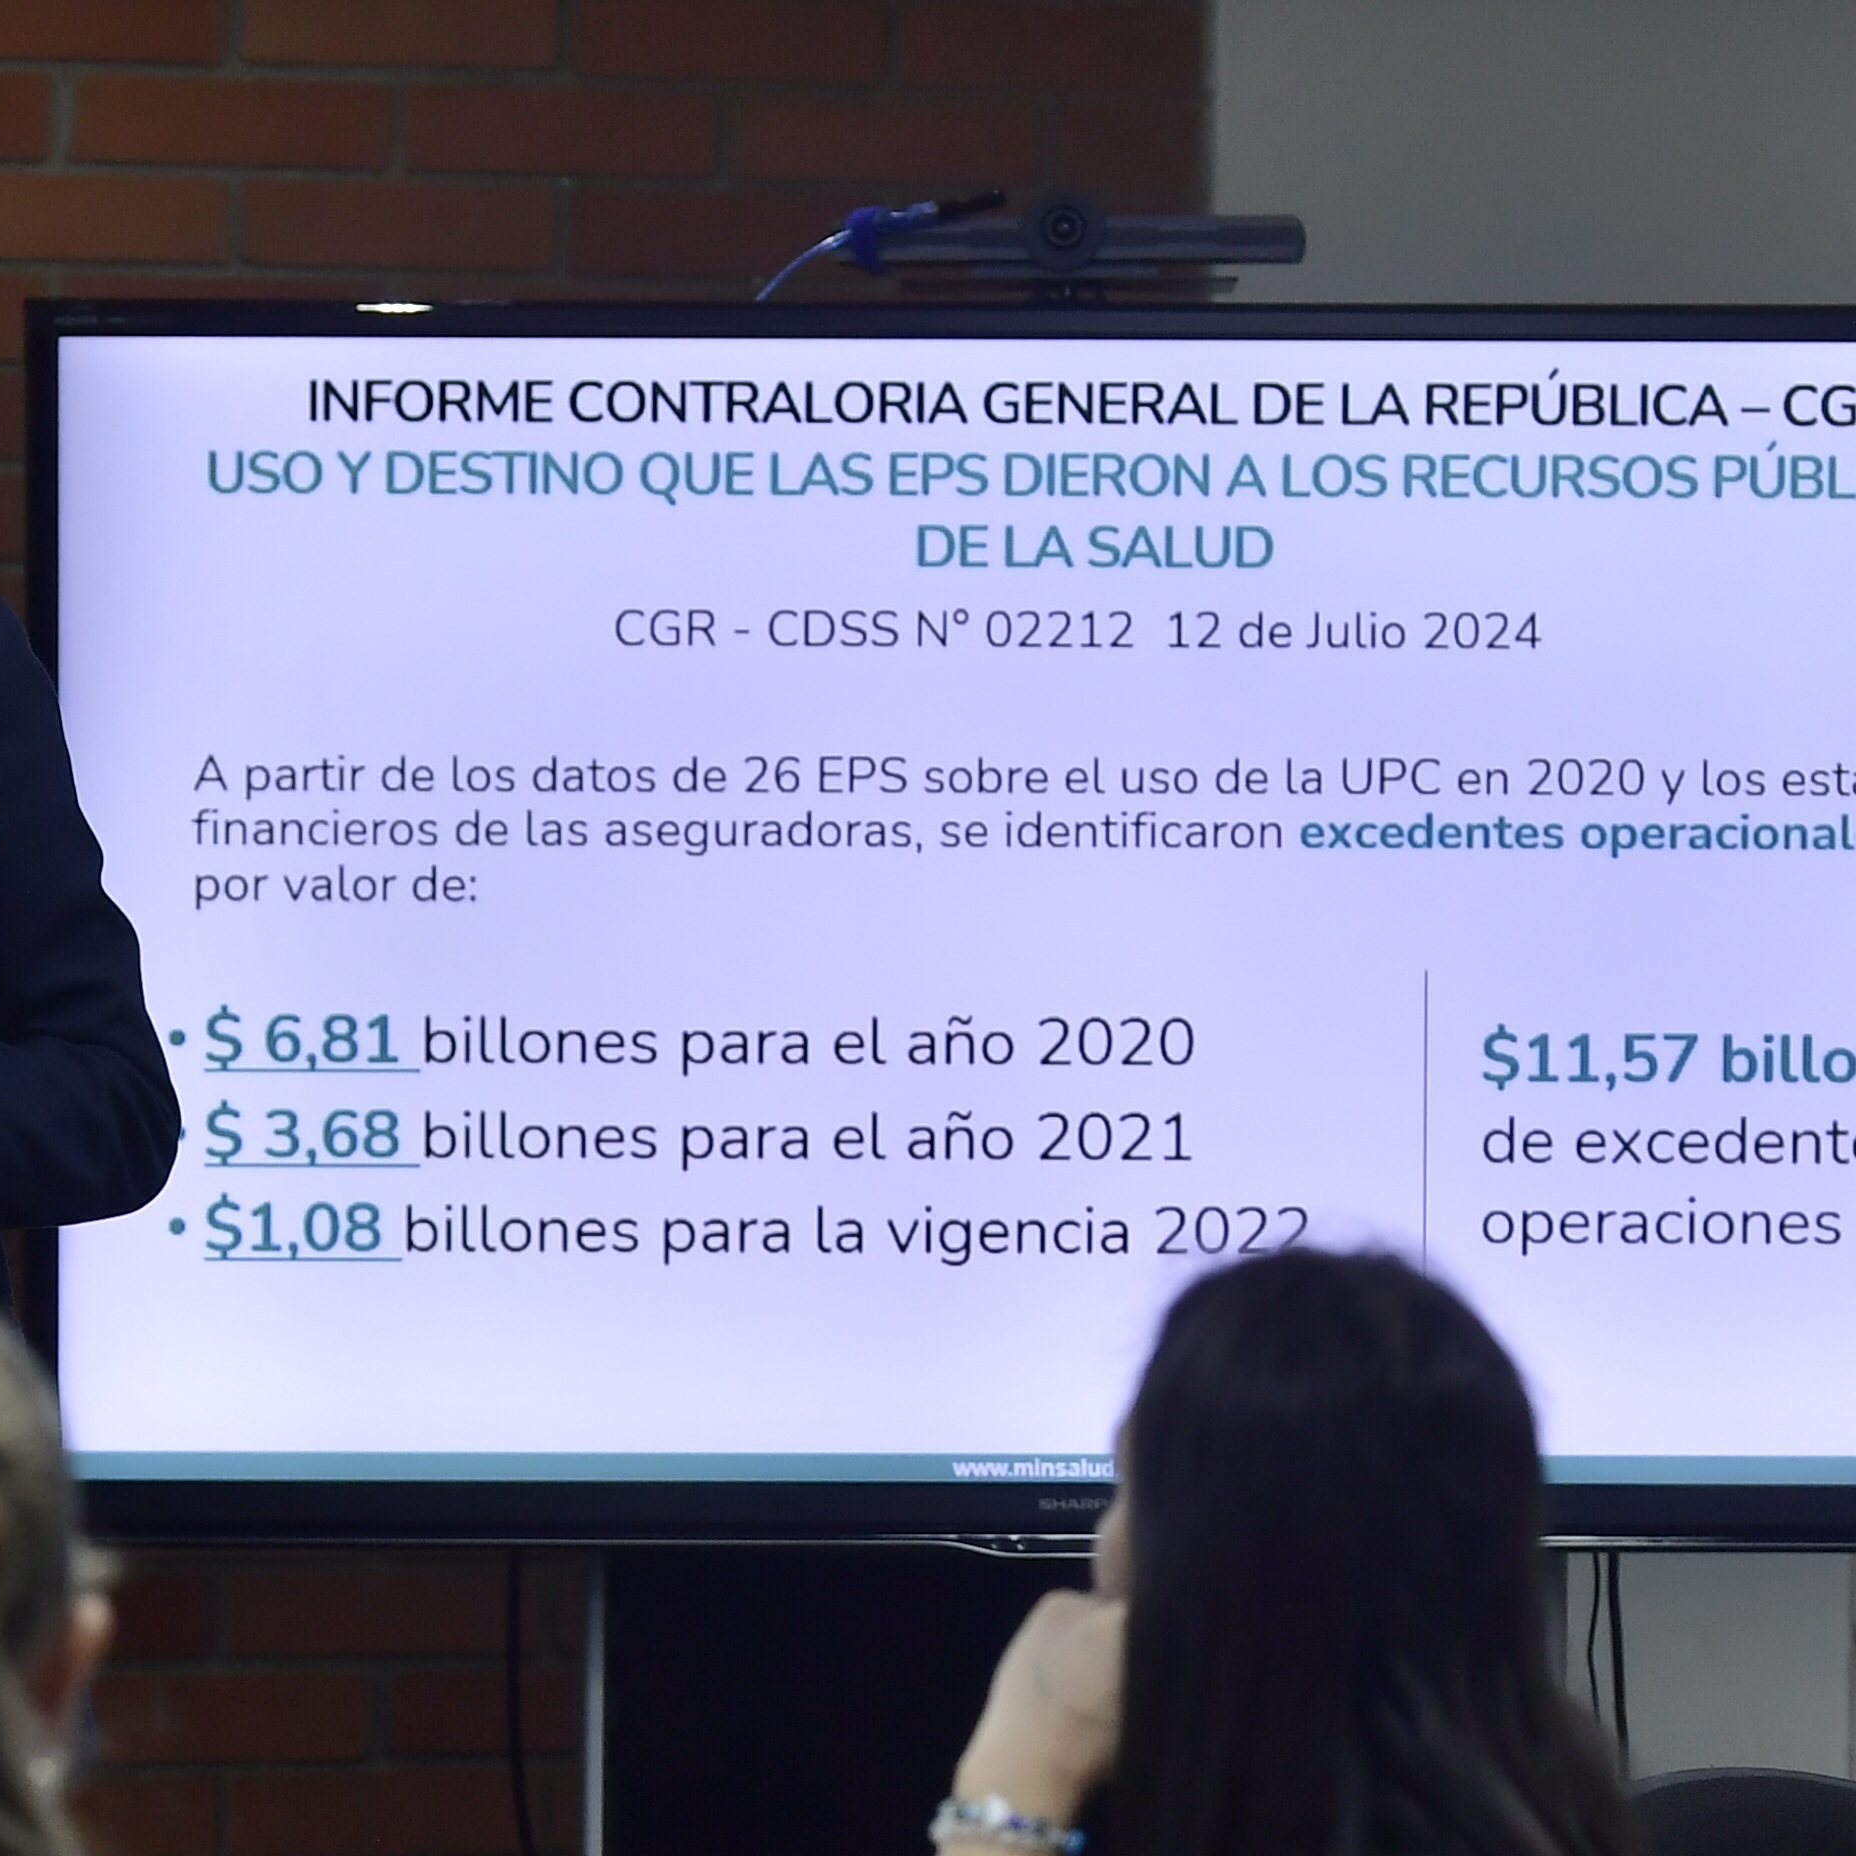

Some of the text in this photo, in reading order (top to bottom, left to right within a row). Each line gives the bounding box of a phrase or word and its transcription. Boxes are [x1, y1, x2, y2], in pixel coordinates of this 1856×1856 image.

[308, 378, 555, 425] INFORME
[567, 379, 970, 426] CONTRALORIA
[982, 380, 1240, 427] GENERAL
[1252, 381, 1326, 427] DE
[1340, 381, 1411, 427] LA
[1424, 366, 1730, 429] REPÚBLICA
[207, 448, 324, 495] USO
[336, 449, 373, 495] Y
[384, 449, 625, 496] DESTINO
[638, 450, 755, 506] QUE
[769, 451, 875, 497] LAS
[888, 451, 990, 497] EPS
[1003, 451, 1211, 498] DIERON
[1225, 452, 1268, 498] A
[1281, 452, 1389, 499] LOS
[1402, 452, 1700, 500] RECURSOS
[915, 523, 1275, 570] DE LA SALUD
[614, 608, 717, 648] CGR
[767, 608, 900, 648] CDSS
[985, 609, 1135, 649] 02212
[1167, 610, 1222, 650] 12
[1238, 610, 1293, 650] de
[1305, 610, 1407, 650] Julio
[1423, 611, 1543, 651] 2024
[193, 753, 229, 793] A
[245, 754, 366, 802] partir
[380, 754, 435, 793] de
[451, 754, 516, 793] los
[531, 754, 657, 794] datos
[672, 755, 728, 794] de
[743, 755, 801, 794] 26
[818, 755, 908, 794] EPS
[923, 755, 1050, 795] sobre
[1064, 755, 1106, 795] el
[1120, 766, 1199, 795] uso
[1214, 756, 1269, 796] de
[1285, 756, 1323, 796] la
[1341, 756, 1441, 796] UPC
[1457, 768, 1509, 797] en
[1527, 757, 1645, 797] 2020
[1660, 768, 1686, 807] y
[1702, 757, 1767, 797] los
[191, 807, 439, 847] financieros
[454, 808, 509, 847] de
[525, 808, 589, 848] las
[604, 809, 923, 858] aseguradoras,
[939, 820, 989, 849] se
[1004, 809, 1283, 850] identificaron
[1299, 811, 1565, 850] excedentes
[194, 863, 477, 912] por valor de:
[423, 1013, 658, 1065] billones
[681, 1029, 810, 1077] para
[832, 1014, 888, 1066] el
[906, 1014, 1015, 1067] año
[1037, 1015, 1195, 1067] 2020
[1481, 1022, 1700, 1093] $11,57
[423, 1108, 658, 1160] billones
[680, 1124, 810, 1172] para
[832, 1110, 888, 1161] el
[906, 1109, 1015, 1162] año
[1037, 1110, 1193, 1162] 2021
[1482, 1114, 1554, 1165] de
[204, 1191, 1310, 1268] $1,08 billones para la vigencia 2022
[1481, 1194, 1842, 1257] operaciones
